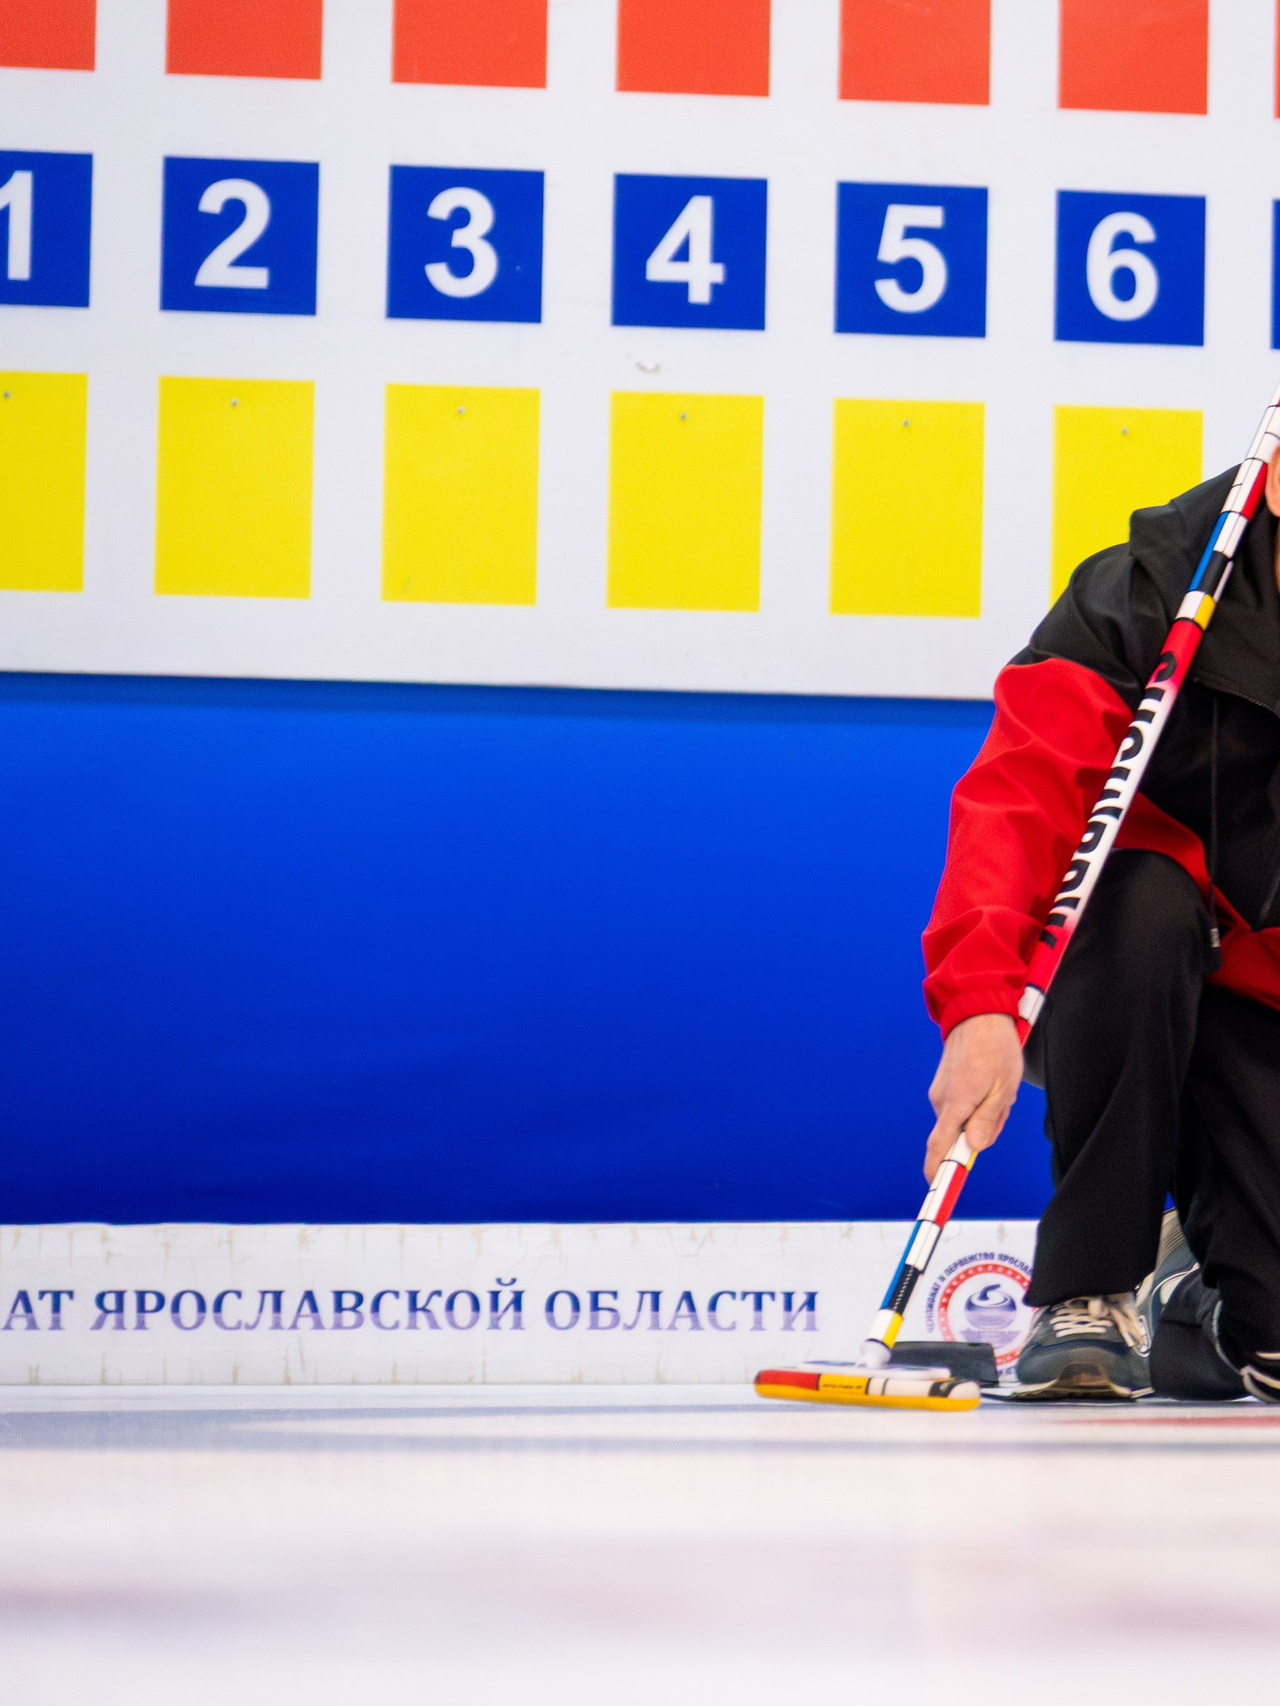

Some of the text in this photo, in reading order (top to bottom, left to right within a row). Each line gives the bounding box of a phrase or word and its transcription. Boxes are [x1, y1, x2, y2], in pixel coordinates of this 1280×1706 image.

[0, 170, 34, 281] 1
[194, 178, 271, 289] 2
[424, 186, 499, 298] 3
[645, 195, 725, 305] 4
[874, 203, 948, 313] 5
[1086, 211, 1159, 321] 6
[90, 1277, 525, 1332] ЯРОСЛАВСКОЙ
[543, 1288, 820, 1332] ОБЛАСТИ
